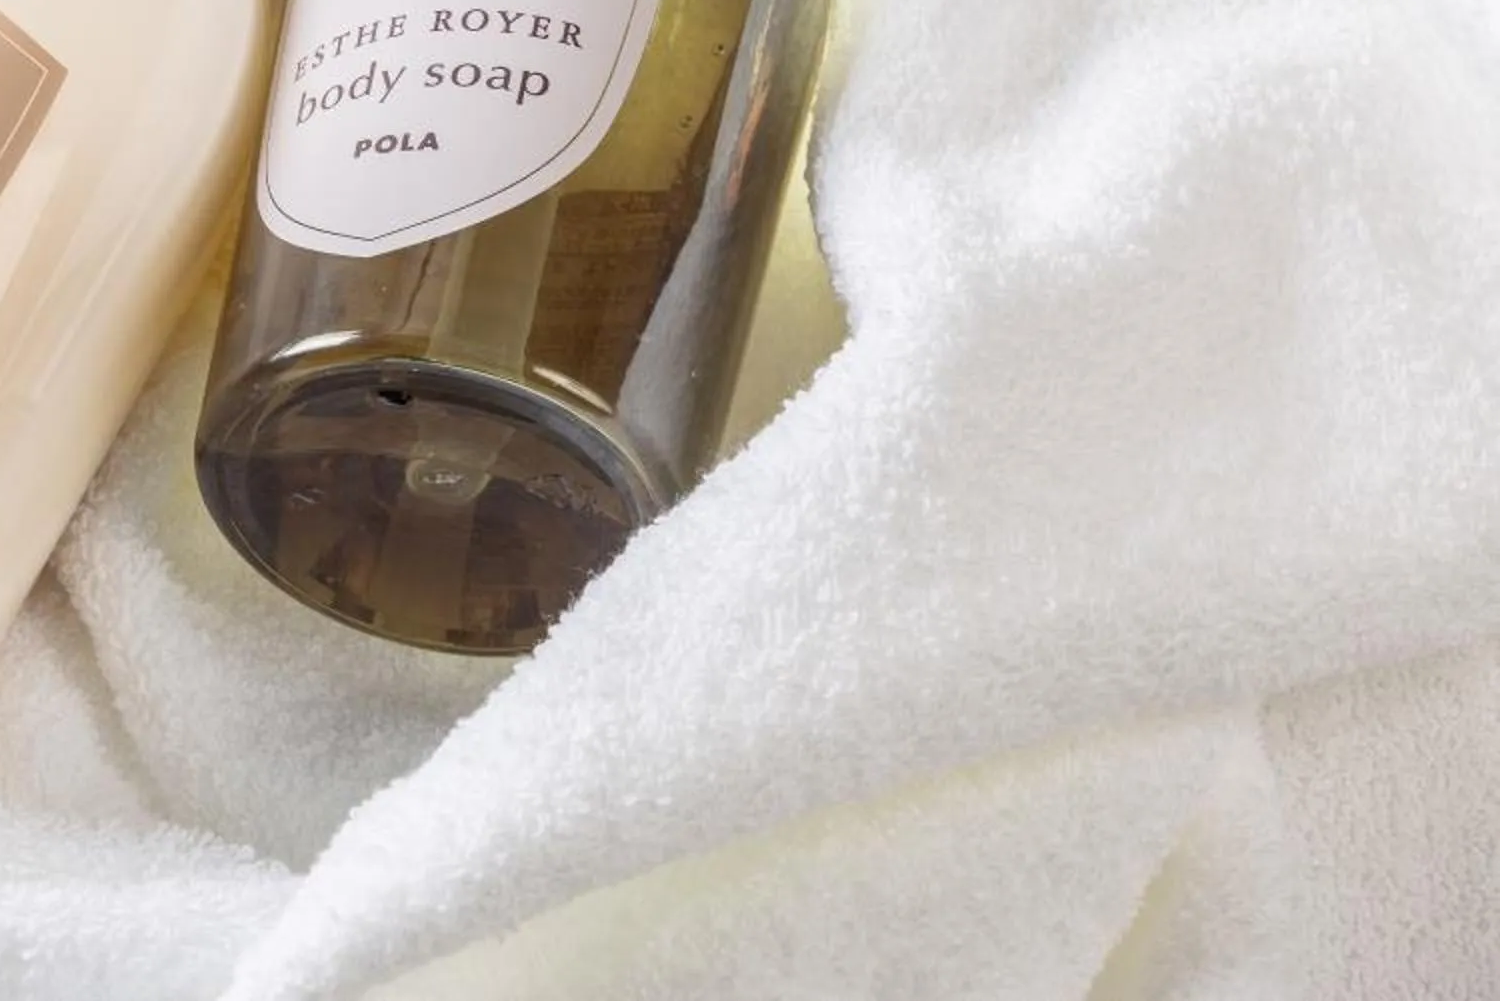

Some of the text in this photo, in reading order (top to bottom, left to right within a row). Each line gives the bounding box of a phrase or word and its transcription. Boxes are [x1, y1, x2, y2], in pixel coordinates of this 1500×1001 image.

[292, 7, 584, 85] ESTHE ROYER
[295, 60, 551, 127] body soap
[353, 131, 440, 159] POLA
